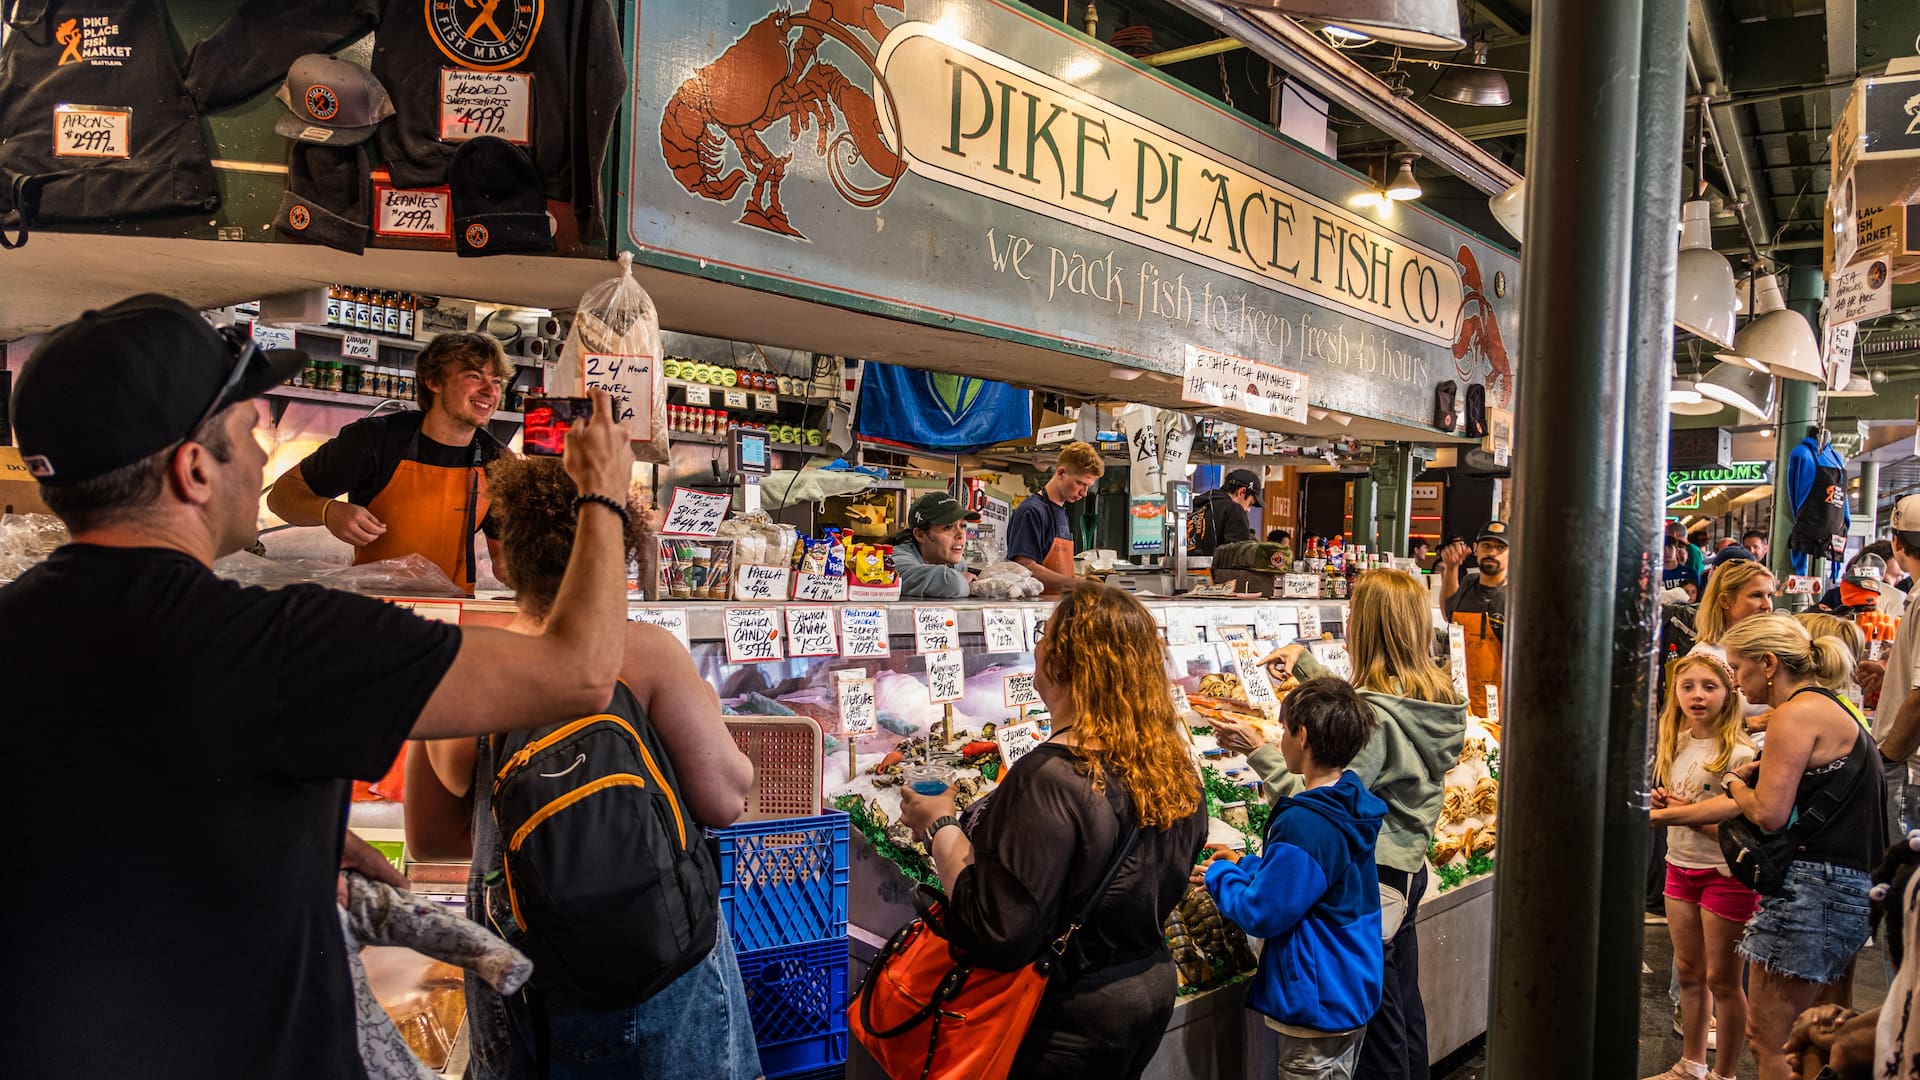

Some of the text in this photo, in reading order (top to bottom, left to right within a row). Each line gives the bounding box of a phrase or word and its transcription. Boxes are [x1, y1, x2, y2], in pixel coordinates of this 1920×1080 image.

[436, 2, 449, 11] SEA
[519, 5, 532, 13] WA
[82, 16, 109, 28] PIKE
[83, 25, 119, 38] PLACE
[438, 16, 529, 58] FISH MARKET
[83, 36, 107, 49] FISH
[82, 46, 132, 58] MARKET
[450, 82, 508, 97] HOODED
[441, 95, 511, 107] SWEATSHIRTS
[62, 114, 115, 129] APRONS
[385, 191, 440, 207] BEANIES
[941, 58, 1445, 329] PIKE PLACE FISH CO.
[1047, 246, 1126, 315] pack
[1137, 261, 1193, 329] fish
[1201, 281, 1228, 332] to
[1238, 292, 1293, 362] keep
[1299, 313, 1350, 370] fresh
[1381, 337, 1429, 388] hours
[627, 364, 649, 373] HOUR
[673, 504, 703, 516] SPICE
[747, 564, 786, 580] PAELLA
[728, 616, 773, 627] SALMON
[788, 608, 828, 622] SALMON
[793, 620, 831, 635] CAVIAR
[733, 629, 772, 643] CANDY
[1002, 726, 1032, 742] JUMBO
